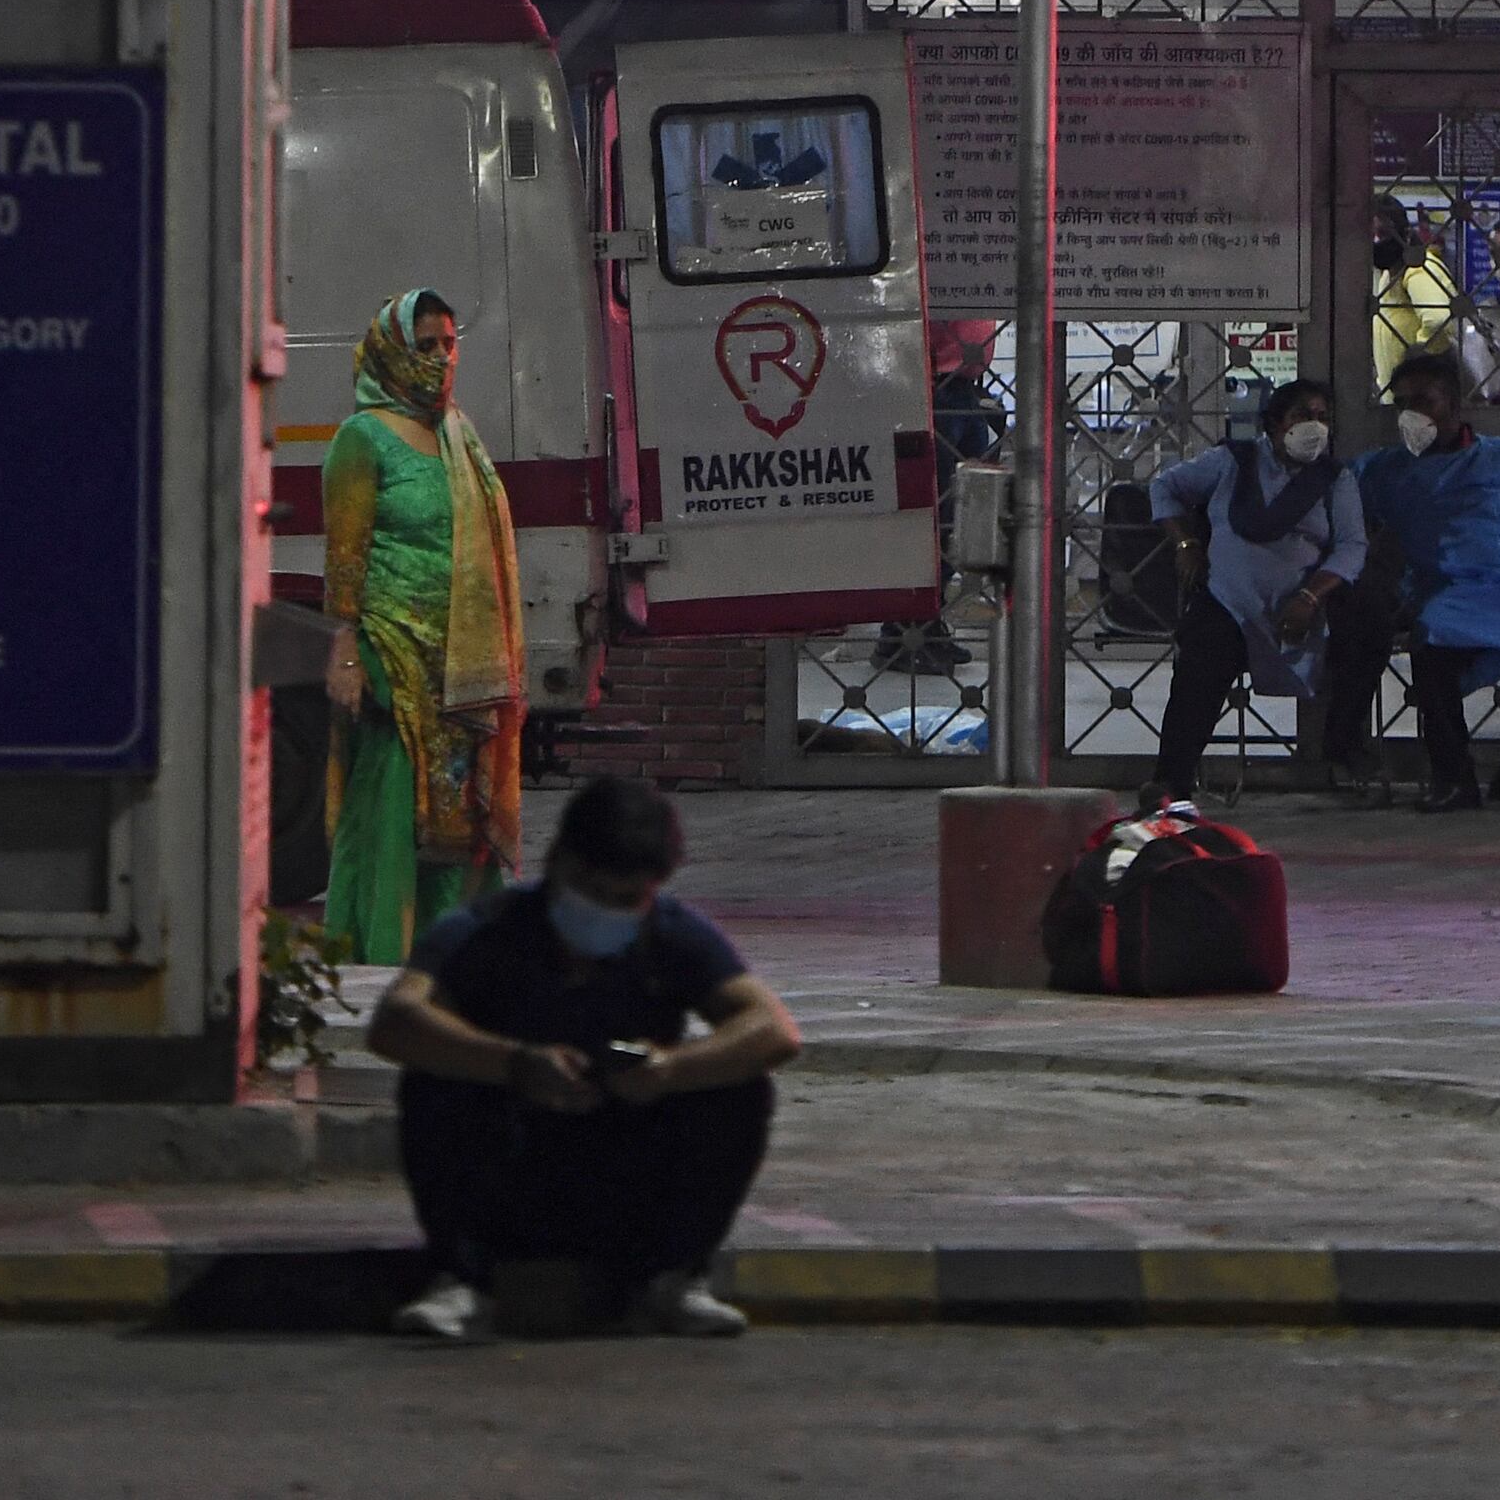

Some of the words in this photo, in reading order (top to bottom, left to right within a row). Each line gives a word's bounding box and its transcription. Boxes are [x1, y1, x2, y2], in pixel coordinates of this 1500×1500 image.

[758, 217, 795, 232] CWG
[683, 445, 871, 494] RAKKSHAK
[685, 497, 770, 513] PROTECT
[803, 489, 875, 506] RESCUE
